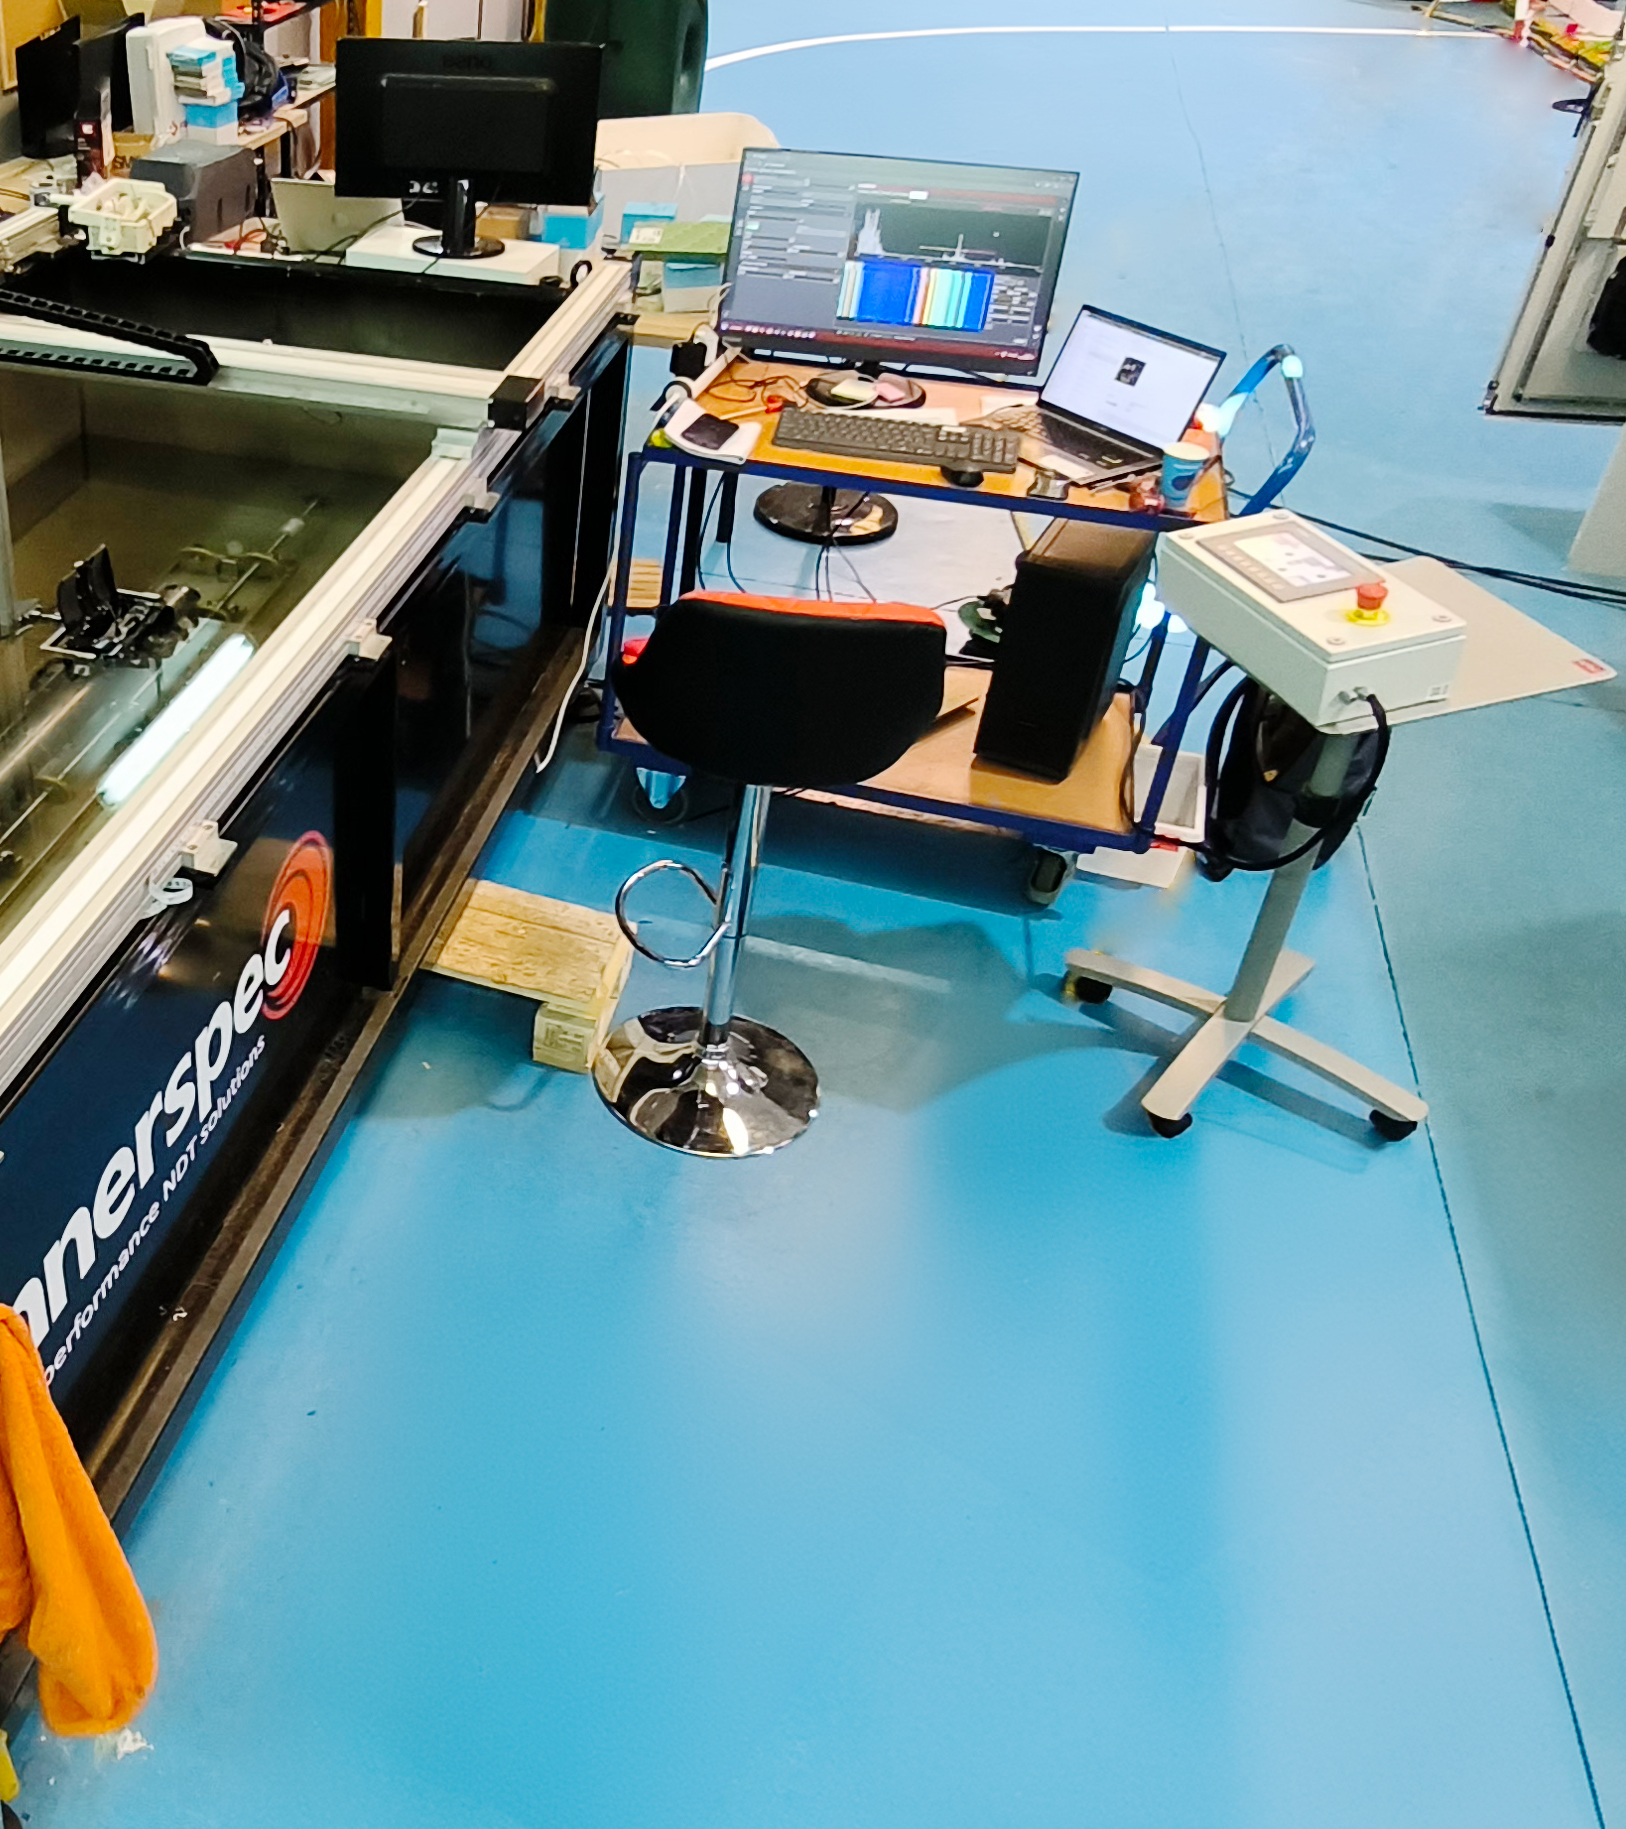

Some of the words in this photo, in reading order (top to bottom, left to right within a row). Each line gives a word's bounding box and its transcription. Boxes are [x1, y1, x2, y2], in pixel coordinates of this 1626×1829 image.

[13, 909, 292, 1349] nnerspec
[162, 1134, 198, 1202] NDT
[200, 1034, 266, 1145] solutions
